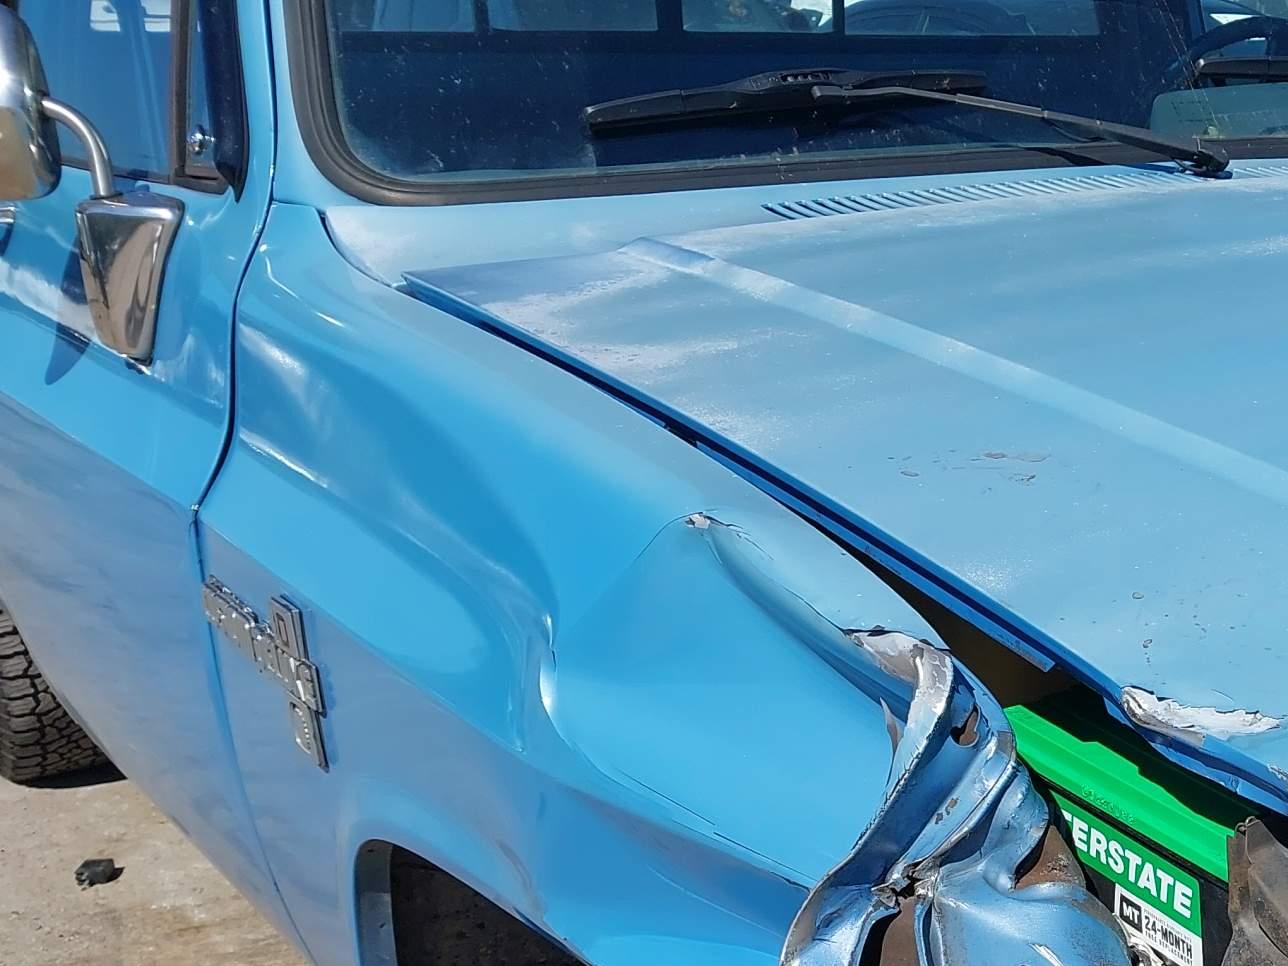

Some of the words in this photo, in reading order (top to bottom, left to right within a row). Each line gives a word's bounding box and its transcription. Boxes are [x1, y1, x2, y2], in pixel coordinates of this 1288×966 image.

[1061, 808, 1193, 919] ERSTATE
[1121, 901, 1140, 924] MT
[1144, 915, 1193, 960] 24-MONTH
